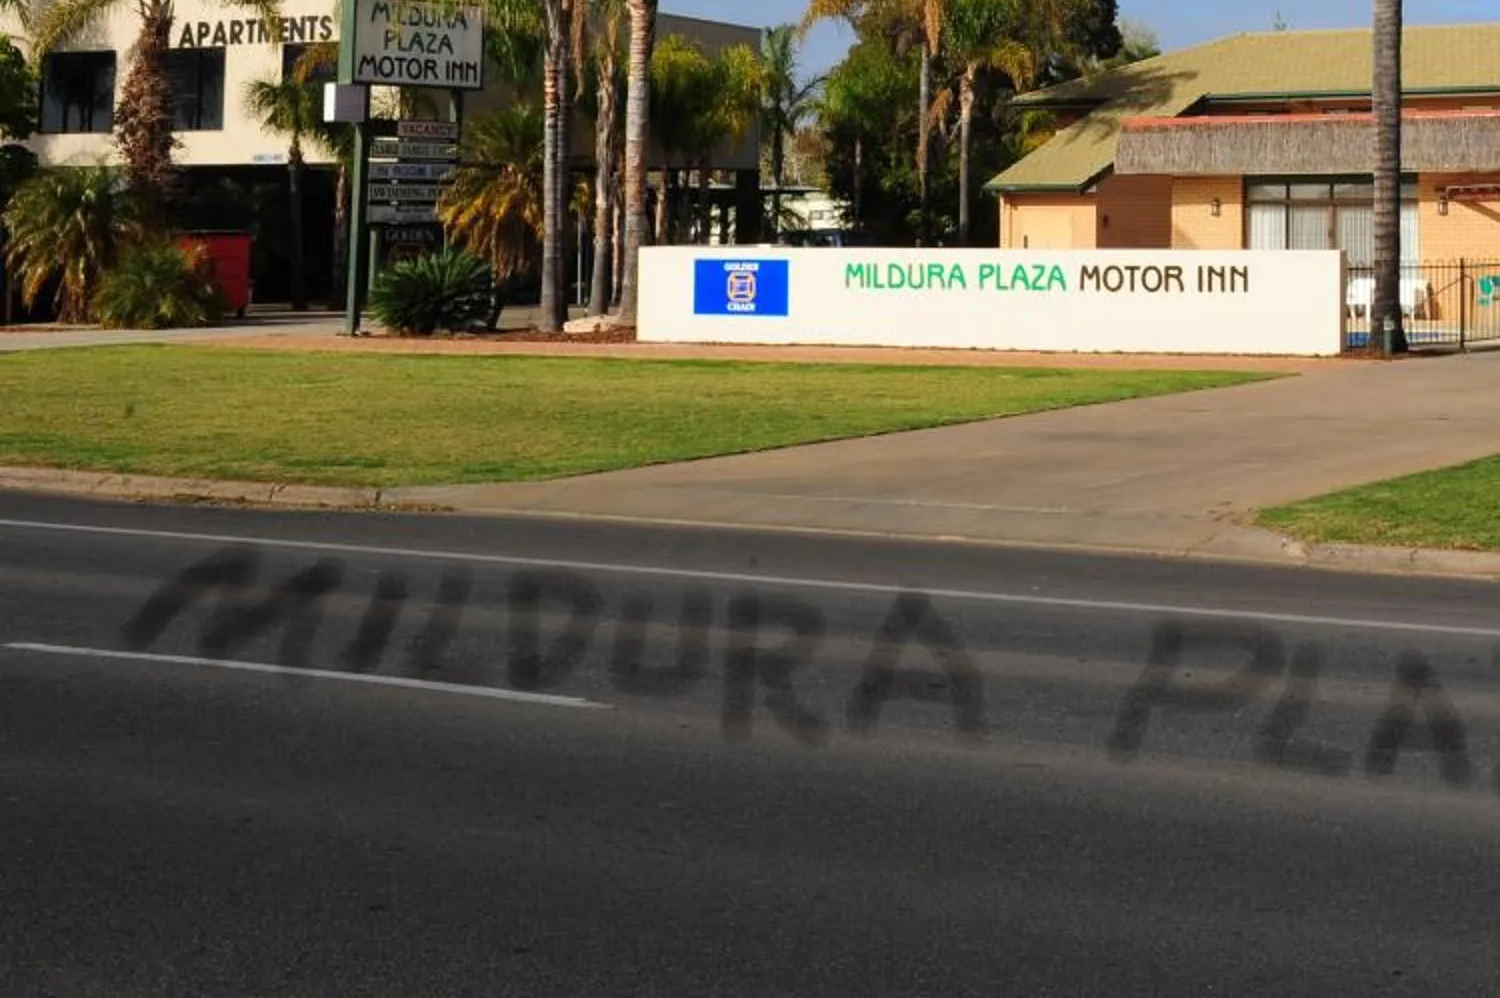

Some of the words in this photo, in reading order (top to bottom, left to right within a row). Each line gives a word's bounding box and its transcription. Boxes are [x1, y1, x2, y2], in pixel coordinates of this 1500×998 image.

[179, 15, 332, 48] APARTMENTS
[384, 29, 453, 55] PLAZA
[358, 54, 438, 80] MOTOR
[445, 60, 478, 82] INN
[845, 263, 967, 290] MILDURA
[978, 263, 1067, 291] PLAZA
[1080, 264, 1184, 292] MOTOR
[1198, 265, 1249, 292] INN
